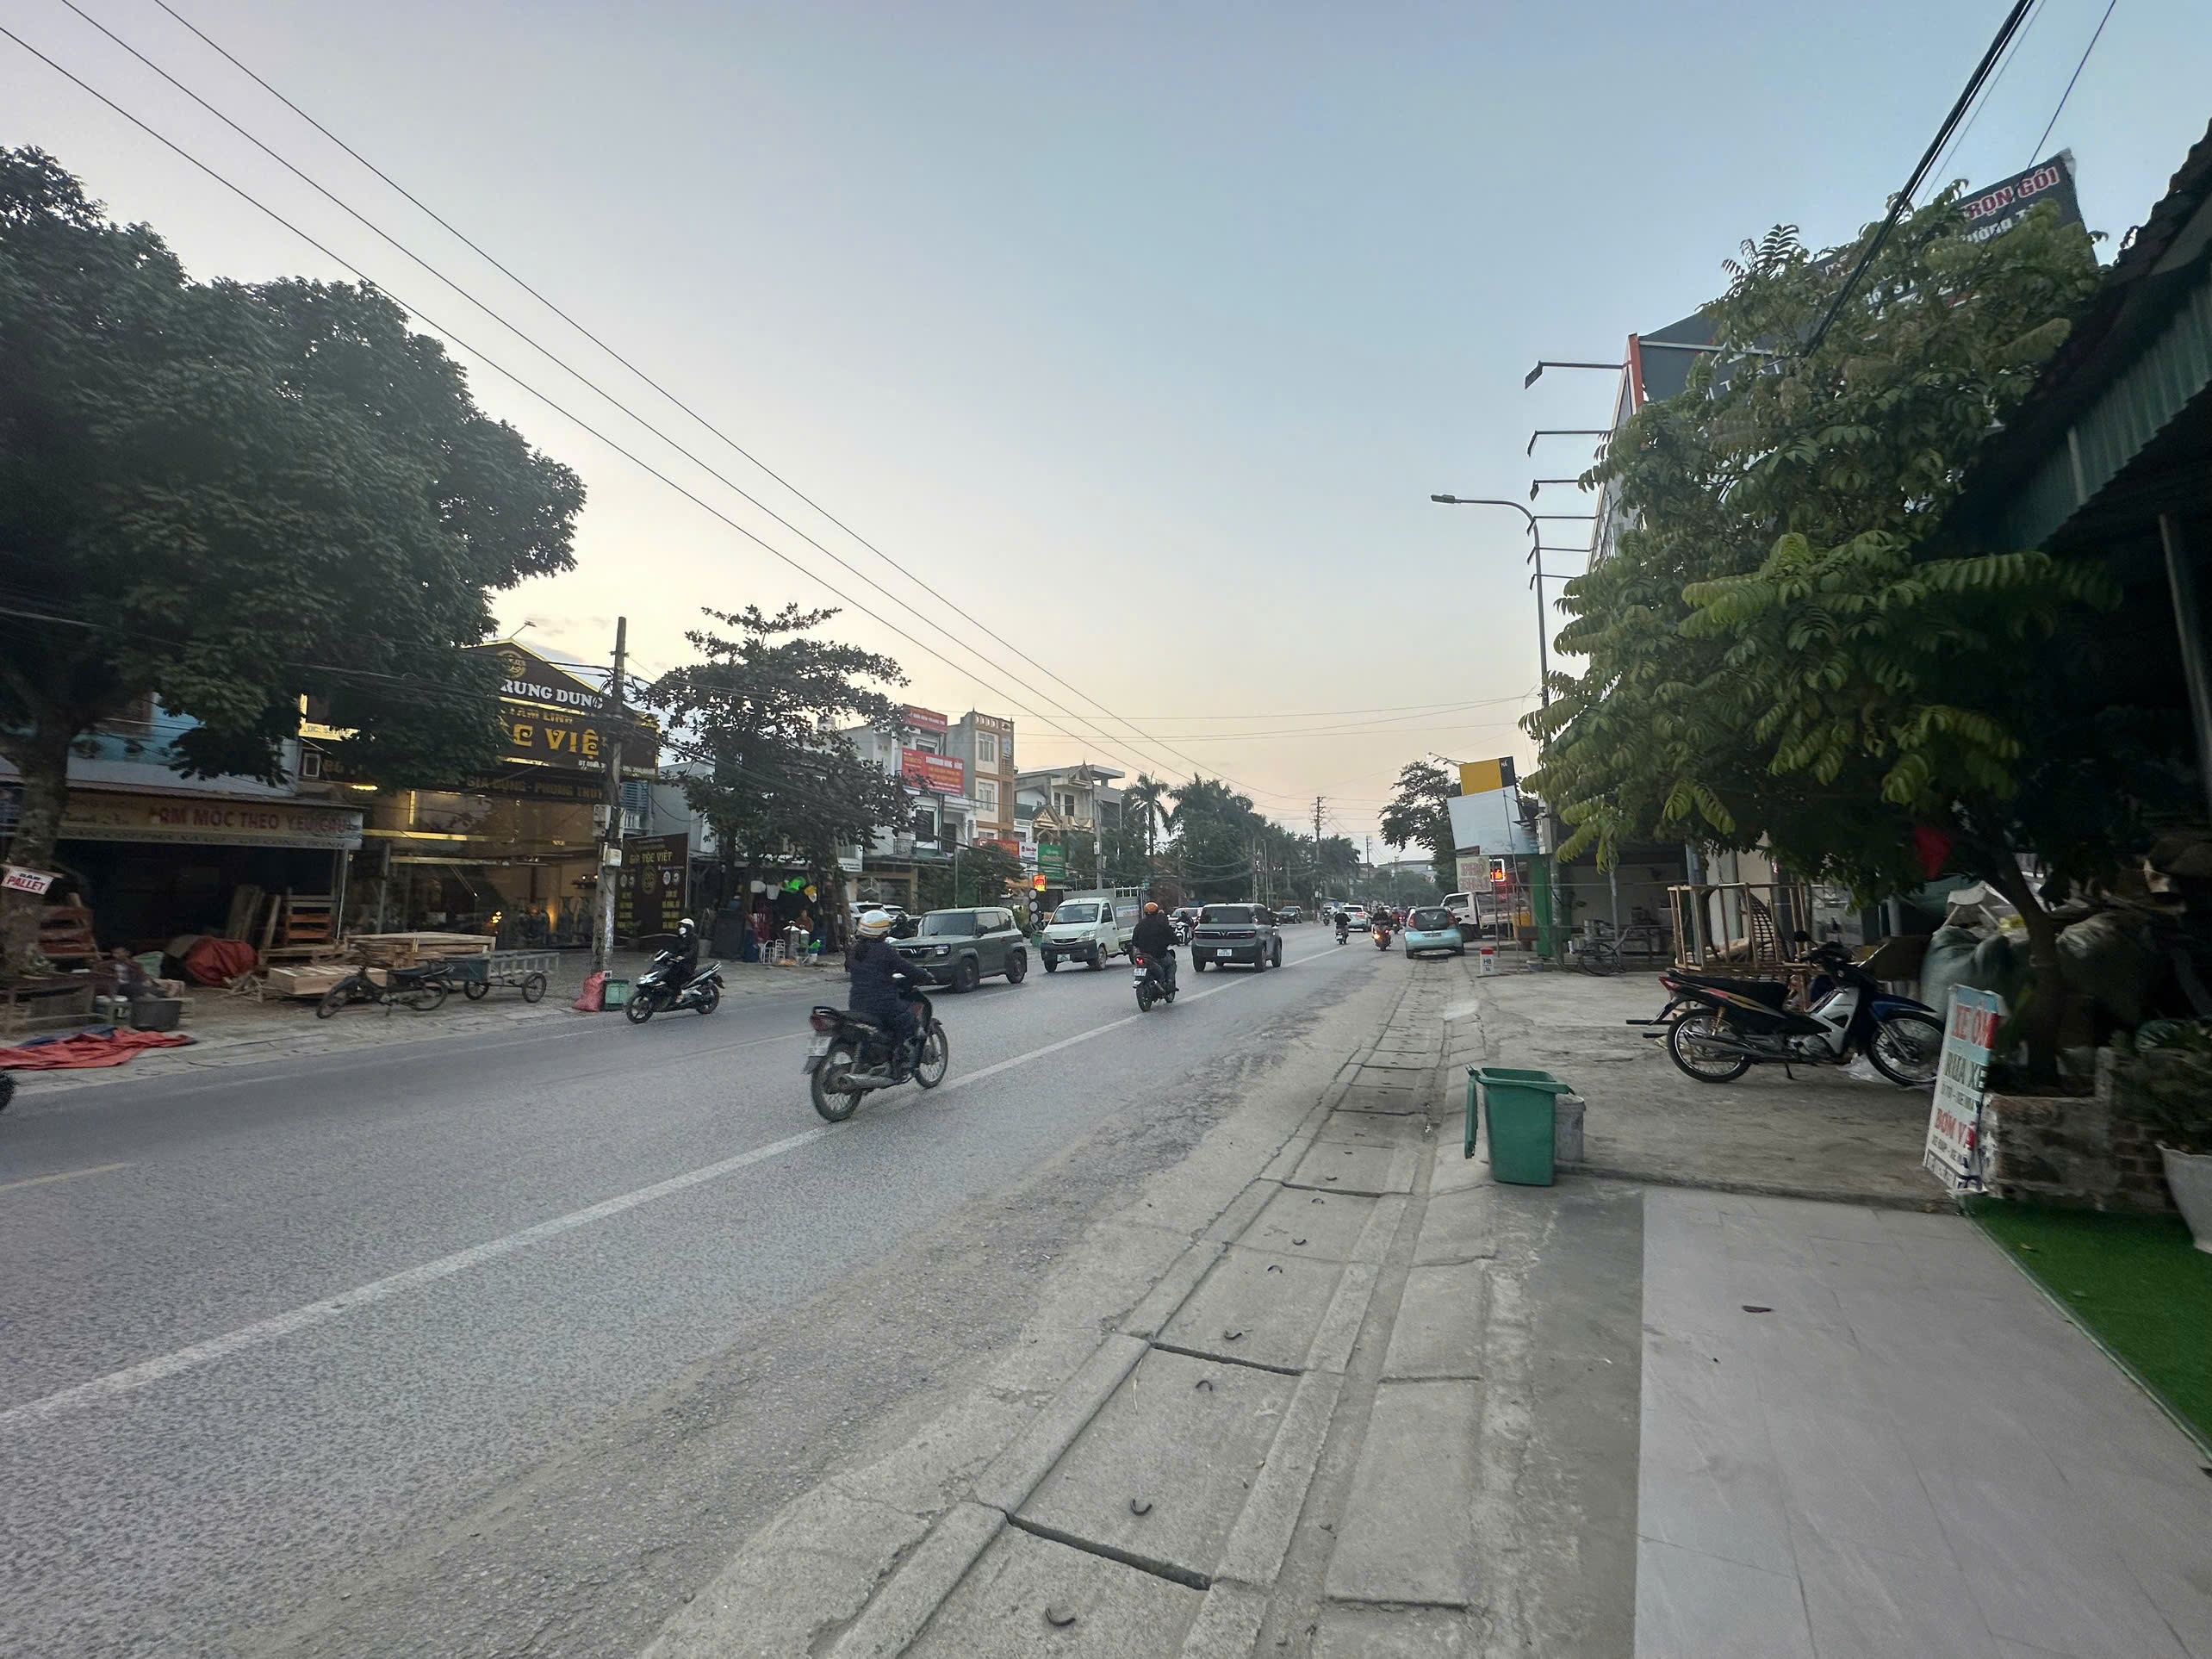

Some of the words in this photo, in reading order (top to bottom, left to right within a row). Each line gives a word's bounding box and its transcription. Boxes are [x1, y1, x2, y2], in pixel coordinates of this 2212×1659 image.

[2017, 166, 2060, 198] GÓI
[500, 679, 553, 699] RUNG
[544, 728, 606, 760] VIỆ
[7, 875, 46, 892] PALLET
